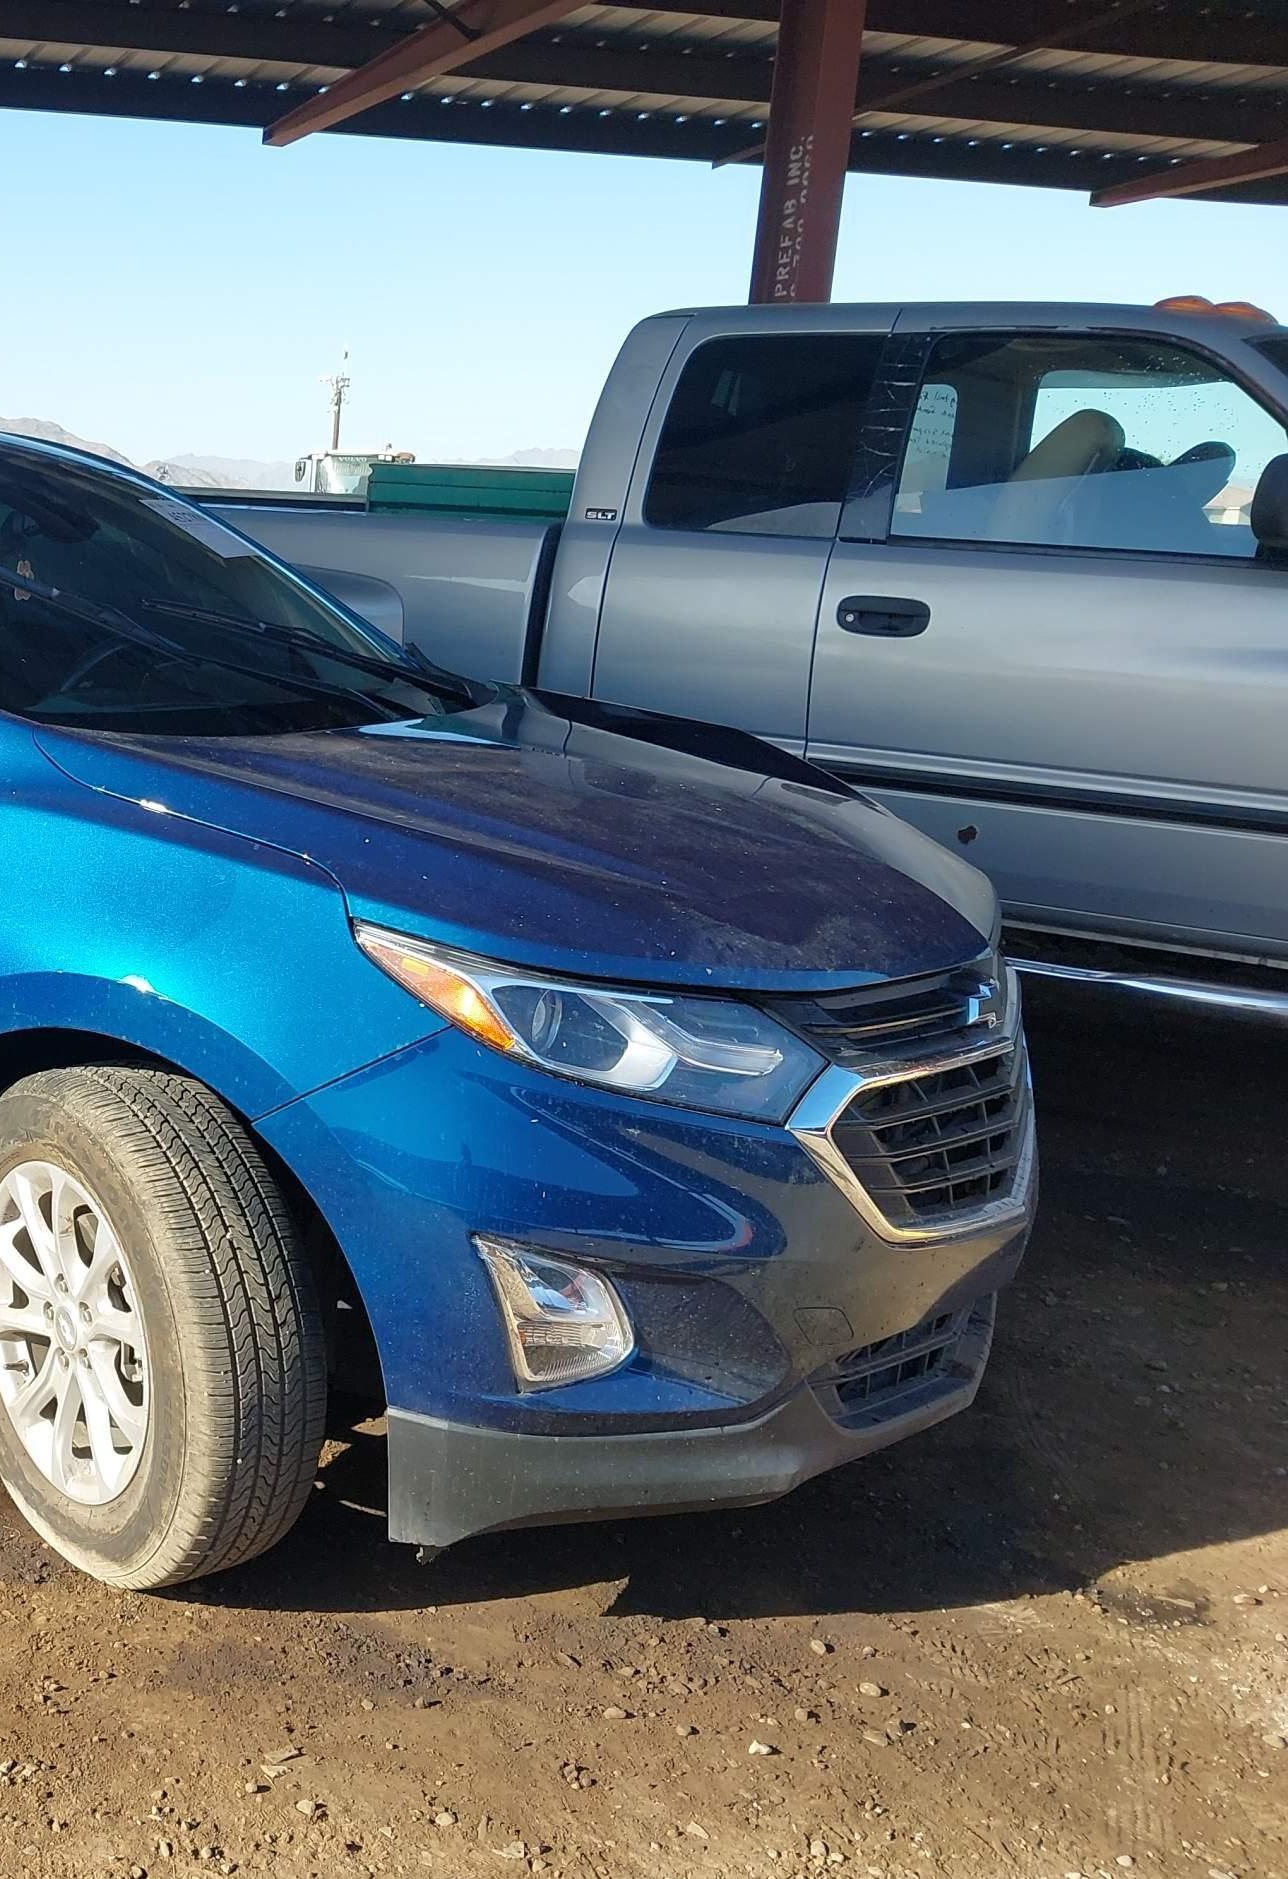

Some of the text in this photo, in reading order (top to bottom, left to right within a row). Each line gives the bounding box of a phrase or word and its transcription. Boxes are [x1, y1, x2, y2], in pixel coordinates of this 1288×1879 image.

[785, 136, 805, 186] INC.
[774, 199, 798, 297] PREFAB
[586, 511, 616, 520] SLT
